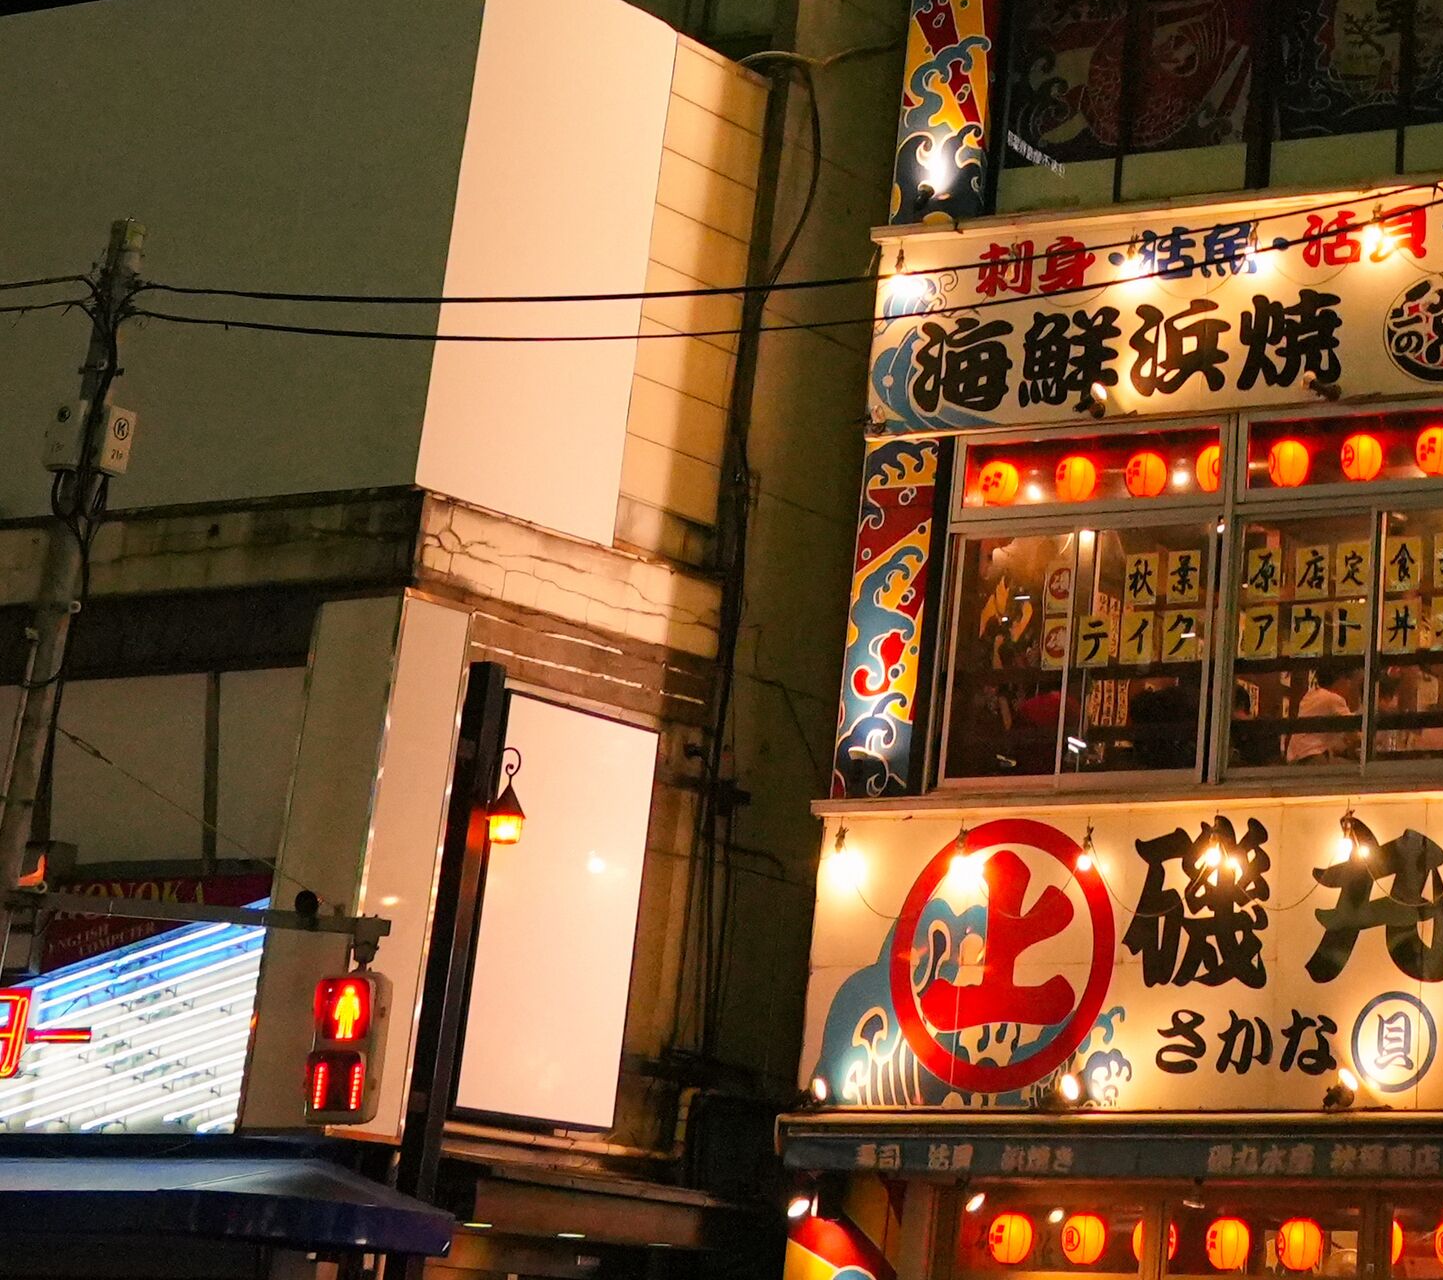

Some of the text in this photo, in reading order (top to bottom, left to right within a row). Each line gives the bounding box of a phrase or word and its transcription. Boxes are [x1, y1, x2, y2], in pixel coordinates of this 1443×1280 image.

[913, 288, 1342, 412] 海鮮浜焼
[1156, 1009, 1337, 1077] さかな
